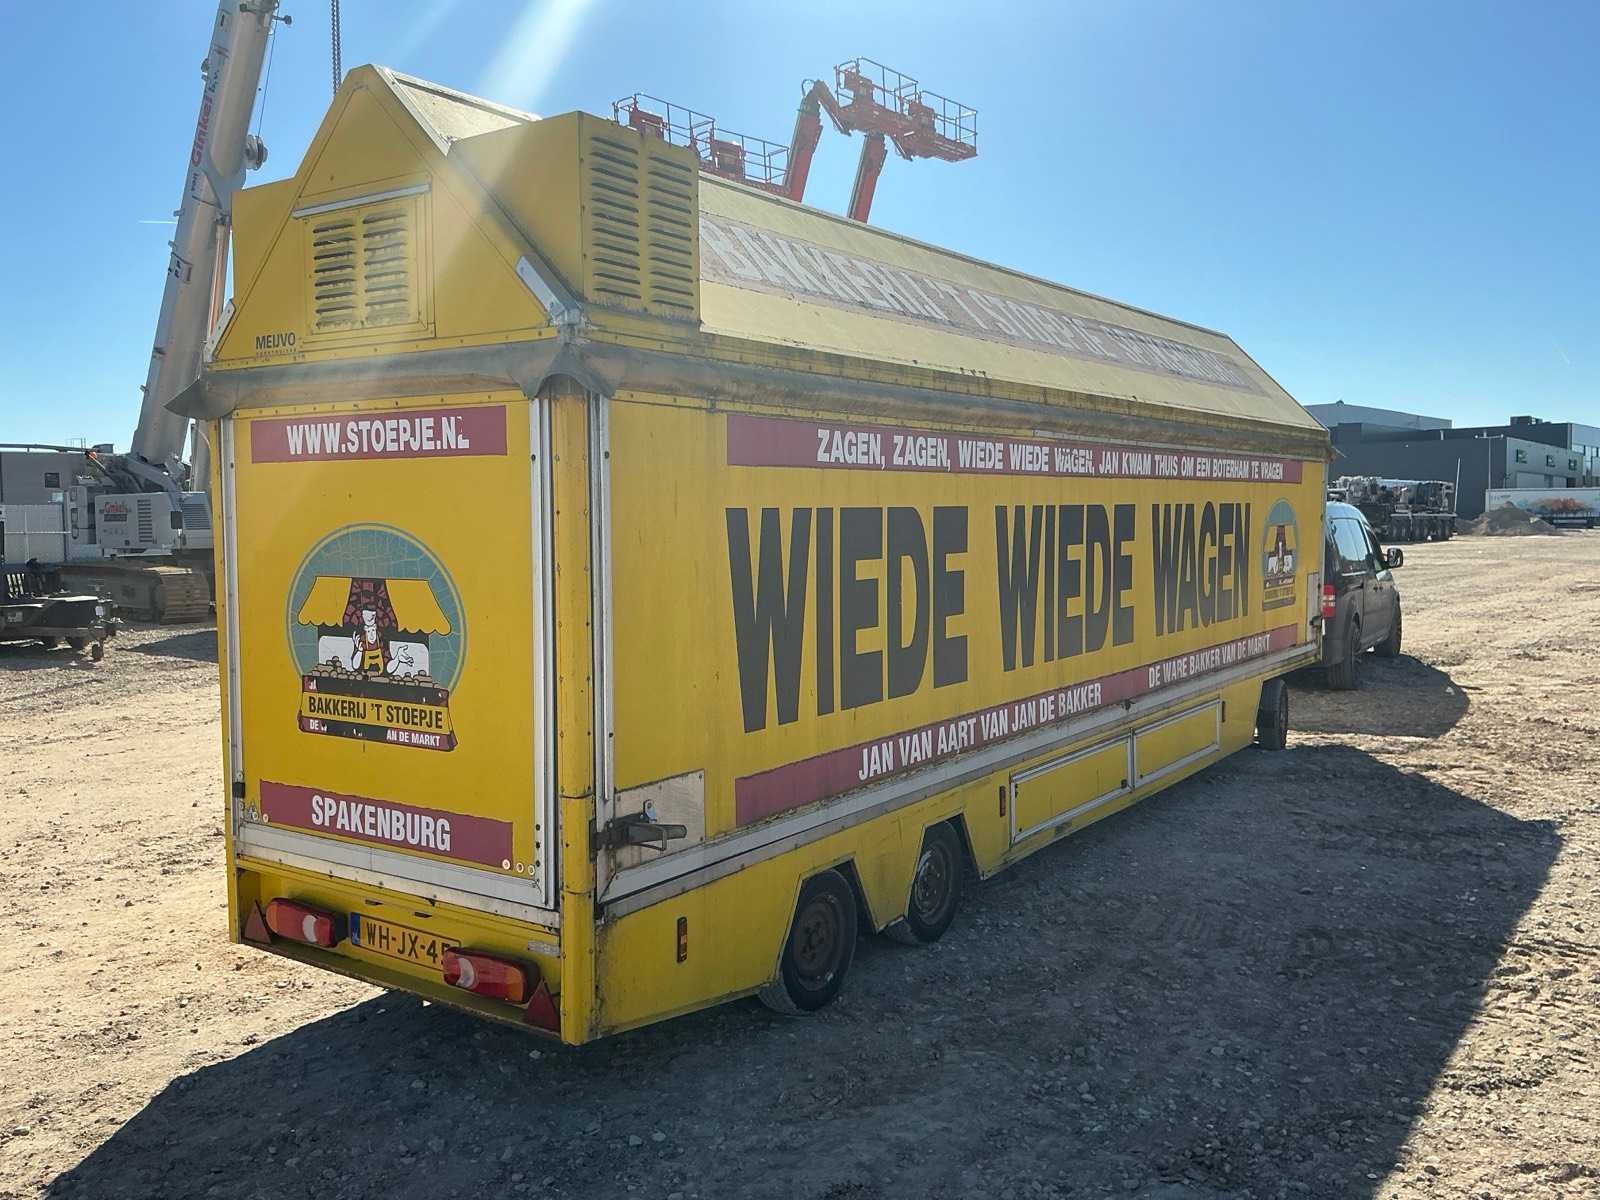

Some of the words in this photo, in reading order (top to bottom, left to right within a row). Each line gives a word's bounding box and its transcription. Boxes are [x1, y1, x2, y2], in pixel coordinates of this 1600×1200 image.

[816, 428, 886, 470] ZAGEN,
[893, 435, 951, 472] ZAGEN,
[958, 439, 1004, 470] WIEDE
[1009, 443, 1050, 472] WIEDE
[1054, 447, 1095, 476] WAGEN,
[1098, 450, 1119, 474] JAN
[1121, 451, 1152, 476] KWAM
[1154, 454, 1178, 477] THUIS
[1180, 456, 1194, 478] OM
[1196, 458, 1211, 479] EEN
[1212, 459, 1249, 480] BOTERHAM
[1250, 460, 1259, 480] TE
[1260, 461, 1284, 481] VRAGEN
[725, 504, 969, 734] WIEDE
[994, 503, 1136, 673] WIEDE
[1151, 501, 1251, 637] WAGEN
[1148, 666, 1161, 689] DE
[1163, 657, 1188, 683] WARE
[1189, 648, 1221, 675] BAKKER
[1221, 643, 1237, 664] VAN
[1237, 639, 1247, 659] DE
[1247, 634, 1271, 656] MARKT
[308, 695, 367, 720] BAKKERIJ
[371, 703, 383, 721] 'T
[386, 704, 443, 729] STOEPJE
[309, 719, 319, 730] DE
[399, 731, 410, 743] DE
[411, 732, 441, 747] MARKT
[858, 741, 894, 781] JAN
[899, 729, 932, 767] VAN
[937, 717, 977, 756] AART
[980, 708, 1009, 741] VAN
[1011, 700, 1036, 732] JAN
[1039, 695, 1055, 723] DE
[1058, 683, 1102, 717] BAKKER
[311, 794, 451, 851] SPAKENBURG
